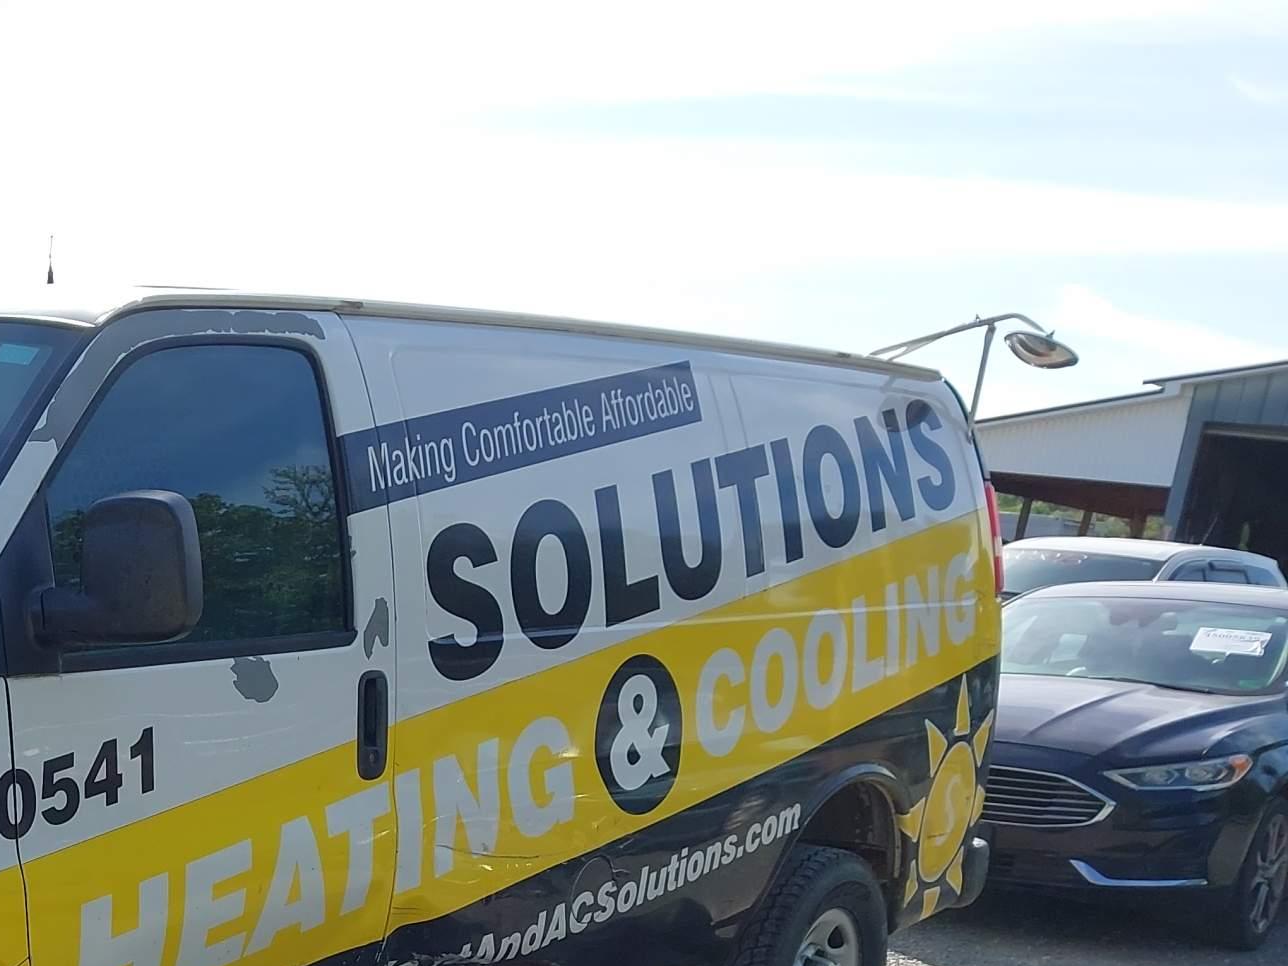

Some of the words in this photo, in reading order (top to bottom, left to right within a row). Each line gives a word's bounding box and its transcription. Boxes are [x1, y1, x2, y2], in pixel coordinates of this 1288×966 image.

[367, 433, 457, 492] Making
[462, 397, 595, 467] Comfortable
[601, 376, 694, 433] Affordable
[426, 399, 957, 682] SOLUTIONS
[610, 673, 671, 792] &
[695, 552, 980, 758] COOLING
